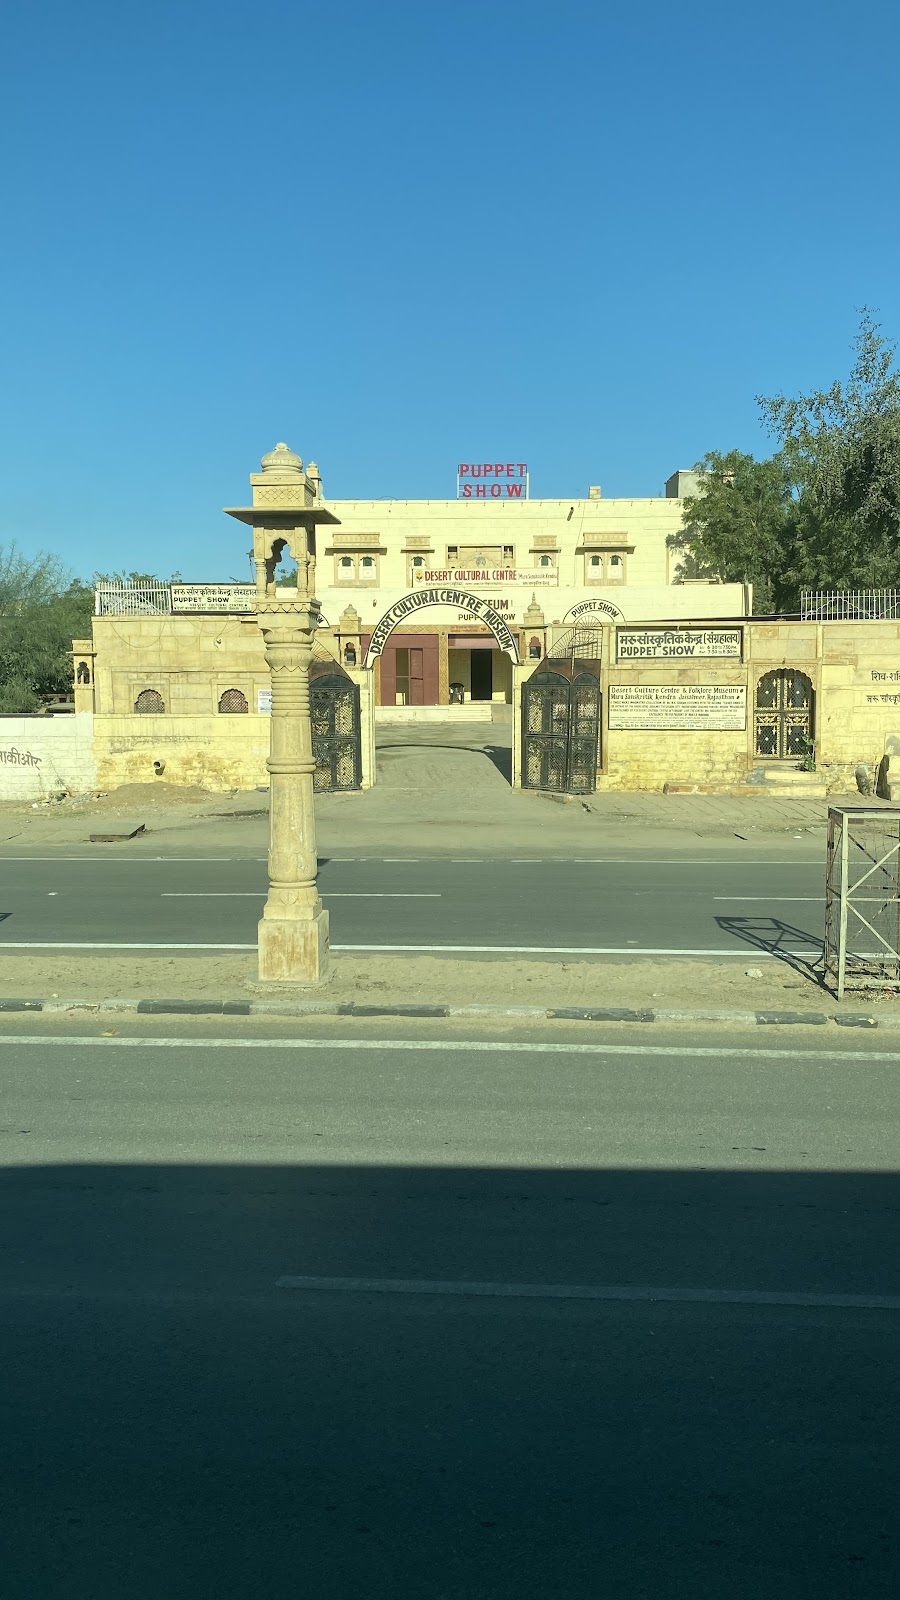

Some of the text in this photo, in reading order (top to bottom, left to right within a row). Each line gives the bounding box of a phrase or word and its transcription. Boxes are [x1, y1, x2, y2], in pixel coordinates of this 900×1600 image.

[459, 463, 527, 478] PUPPET
[462, 484, 523, 498] SHOW
[425, 570, 453, 582] DESERT
[454, 570, 491, 581] CULTURAL
[492, 570, 518, 581] CENTRE
[571, 601, 620, 618] PUPPET SHOW
[369, 613, 397, 655] DESERT
[392, 590, 440, 619] CULTURAL
[440, 590, 484, 614] CENTRE
[620, 646, 658, 657] PUPPET
[662, 645, 695, 656] SHOW
[611, 686, 632, 694] Desert
[634, 686, 660, 694] Culture
[660, 686, 680, 694] Centre
[689, 686, 712, 695] Folklore
